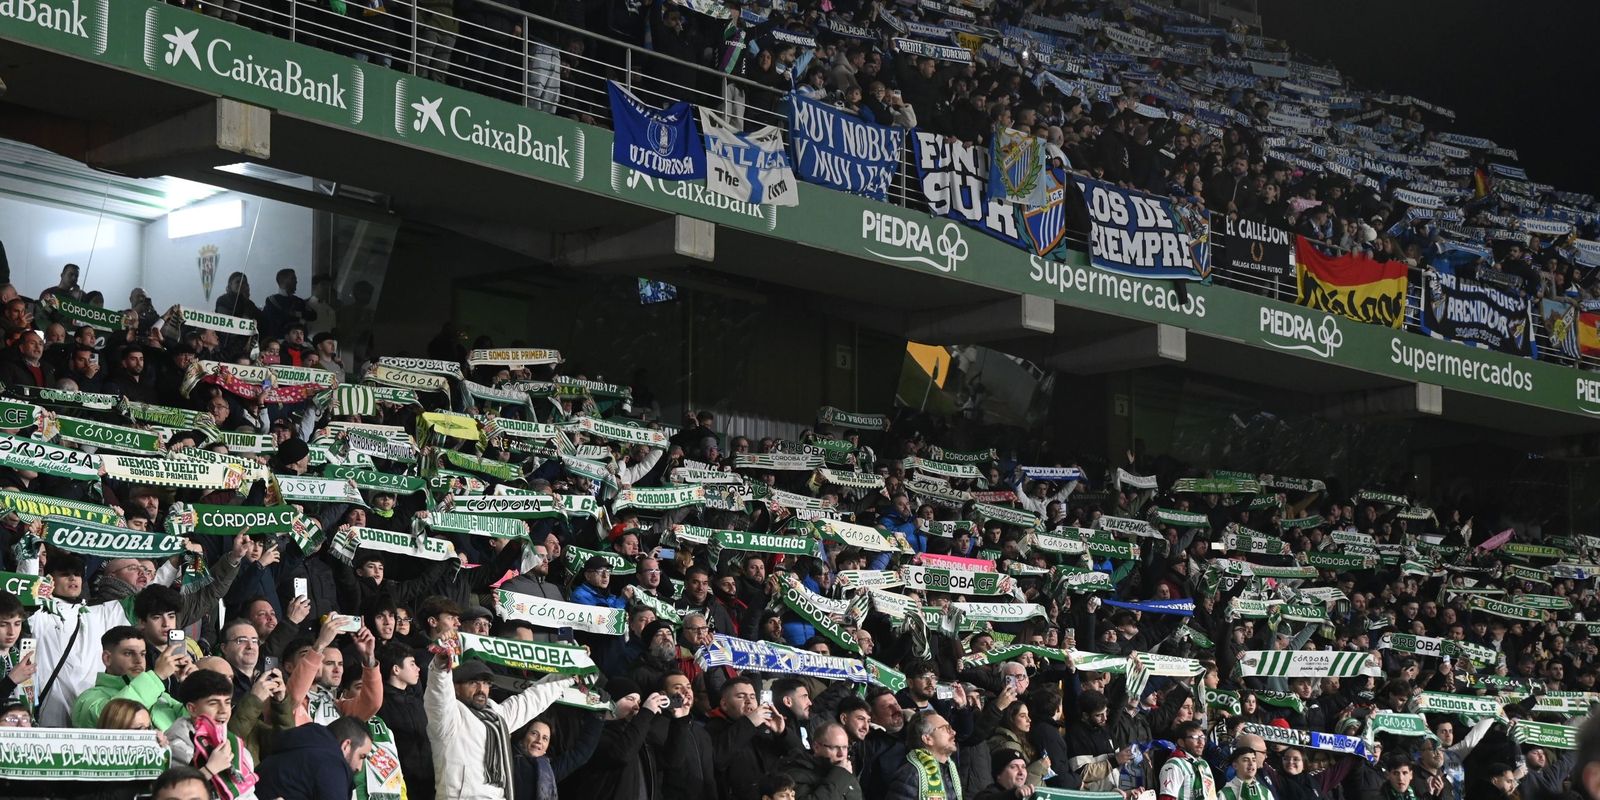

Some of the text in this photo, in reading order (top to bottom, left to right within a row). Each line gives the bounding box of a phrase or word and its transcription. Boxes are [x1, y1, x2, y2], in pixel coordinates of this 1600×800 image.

[207, 39, 347, 109] CaixaBank
[793, 95, 834, 149] MUY
[450, 106, 570, 168] CaixaBank
[811, 146, 851, 189] MUY
[714, 167, 740, 187] The
[923, 170, 1018, 240] SUR
[1397, 192, 1438, 206] INVENCIBLES
[1129, 194, 1173, 229] DE
[1226, 215, 1236, 236] EL
[1527, 221, 1568, 232] INVENCIBLES
[1091, 221, 1193, 270] SIEMPRE
[1030, 253, 1206, 318] Supermercados
[61, 301, 121, 324] CÓRDOBA CF
[488, 349, 548, 360] SOMOS DE PRIMERA
[1391, 338, 1533, 391] Supermercados
[275, 368, 311, 383] CÓRDOBA
[385, 368, 441, 388] CÓRDOBA
[5, 409, 28, 424] CF
[75, 424, 141, 447] CÓRDOBA
[223, 433, 256, 447] LVIENDO
[384, 430, 395, 438] CF
[4, 453, 73, 473] pasión infinita
[117, 456, 210, 474] ¡HEMOS VUELTO!
[945, 451, 989, 462] CÓRDOBA CF
[130, 467, 199, 481] SOMOS DE PRIMERA
[334, 467, 409, 488] CÓRDOBA
[430, 476, 448, 488] CF
[466, 495, 541, 512] CÓRDOBA
[636, 490, 678, 505] CÓRDOBA
[202, 509, 278, 528] CÓRDOBA
[1105, 517, 1148, 533] VOLVEREMOS
[52, 525, 186, 551] CÓRDOBA CF
[359, 527, 446, 554] CÓRDOBA C.F.
[840, 528, 881, 545] CÓRDOBA
[1043, 538, 1078, 550] CÓRDOBA
[1087, 542, 1129, 555] RDOBA CF
[968, 563, 989, 573] GIRLS
[1310, 554, 1362, 567] CÓRDOBA CF
[6, 577, 31, 596] CF
[914, 569, 994, 589] CÓRDOBA CF
[529, 602, 594, 626] CÓRDOBA
[1487, 600, 1524, 617] CÓRDOBA
[841, 630, 858, 646] CF
[1381, 633, 1441, 651] CÓRDOBA
[1292, 653, 1330, 664] CÓRDOBA
[1482, 650, 1493, 659] CF
[504, 659, 527, 669] NUEVO
[1478, 673, 1523, 688] CÓRDOBA
[1429, 697, 1476, 712] CÓRDOBA
[1378, 716, 1417, 731] CÓRDOBA
